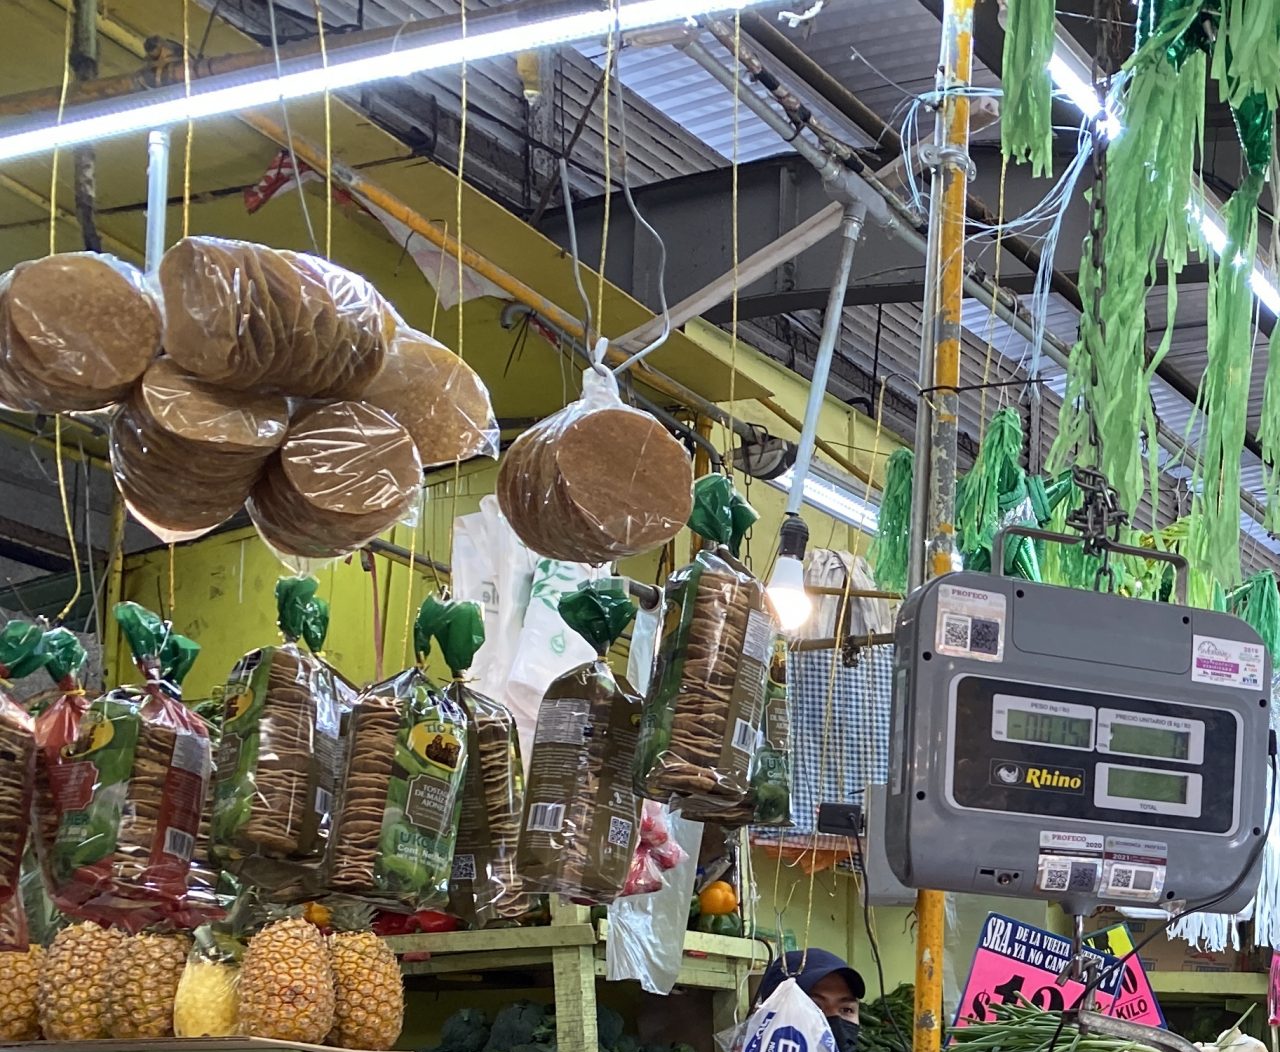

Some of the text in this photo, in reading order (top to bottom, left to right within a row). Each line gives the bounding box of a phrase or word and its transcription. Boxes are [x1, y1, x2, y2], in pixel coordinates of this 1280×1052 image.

[1031, 702, 1048, 710] PESO
[1115, 713, 1138, 721] PRECIO
[1139, 717, 1166, 726] UNITARIO
[1026, 767, 1082, 789] Rhino
[1140, 803, 1157, 811] TOTAL
[1051, 833, 1087, 842] PROFECO
[982, 916, 1071, 958] SRA. DE LA VUELTA
[1013, 942, 1026, 960] YA
[1027, 948, 1044, 966] NO
[1116, 998, 1148, 1020] KILO
